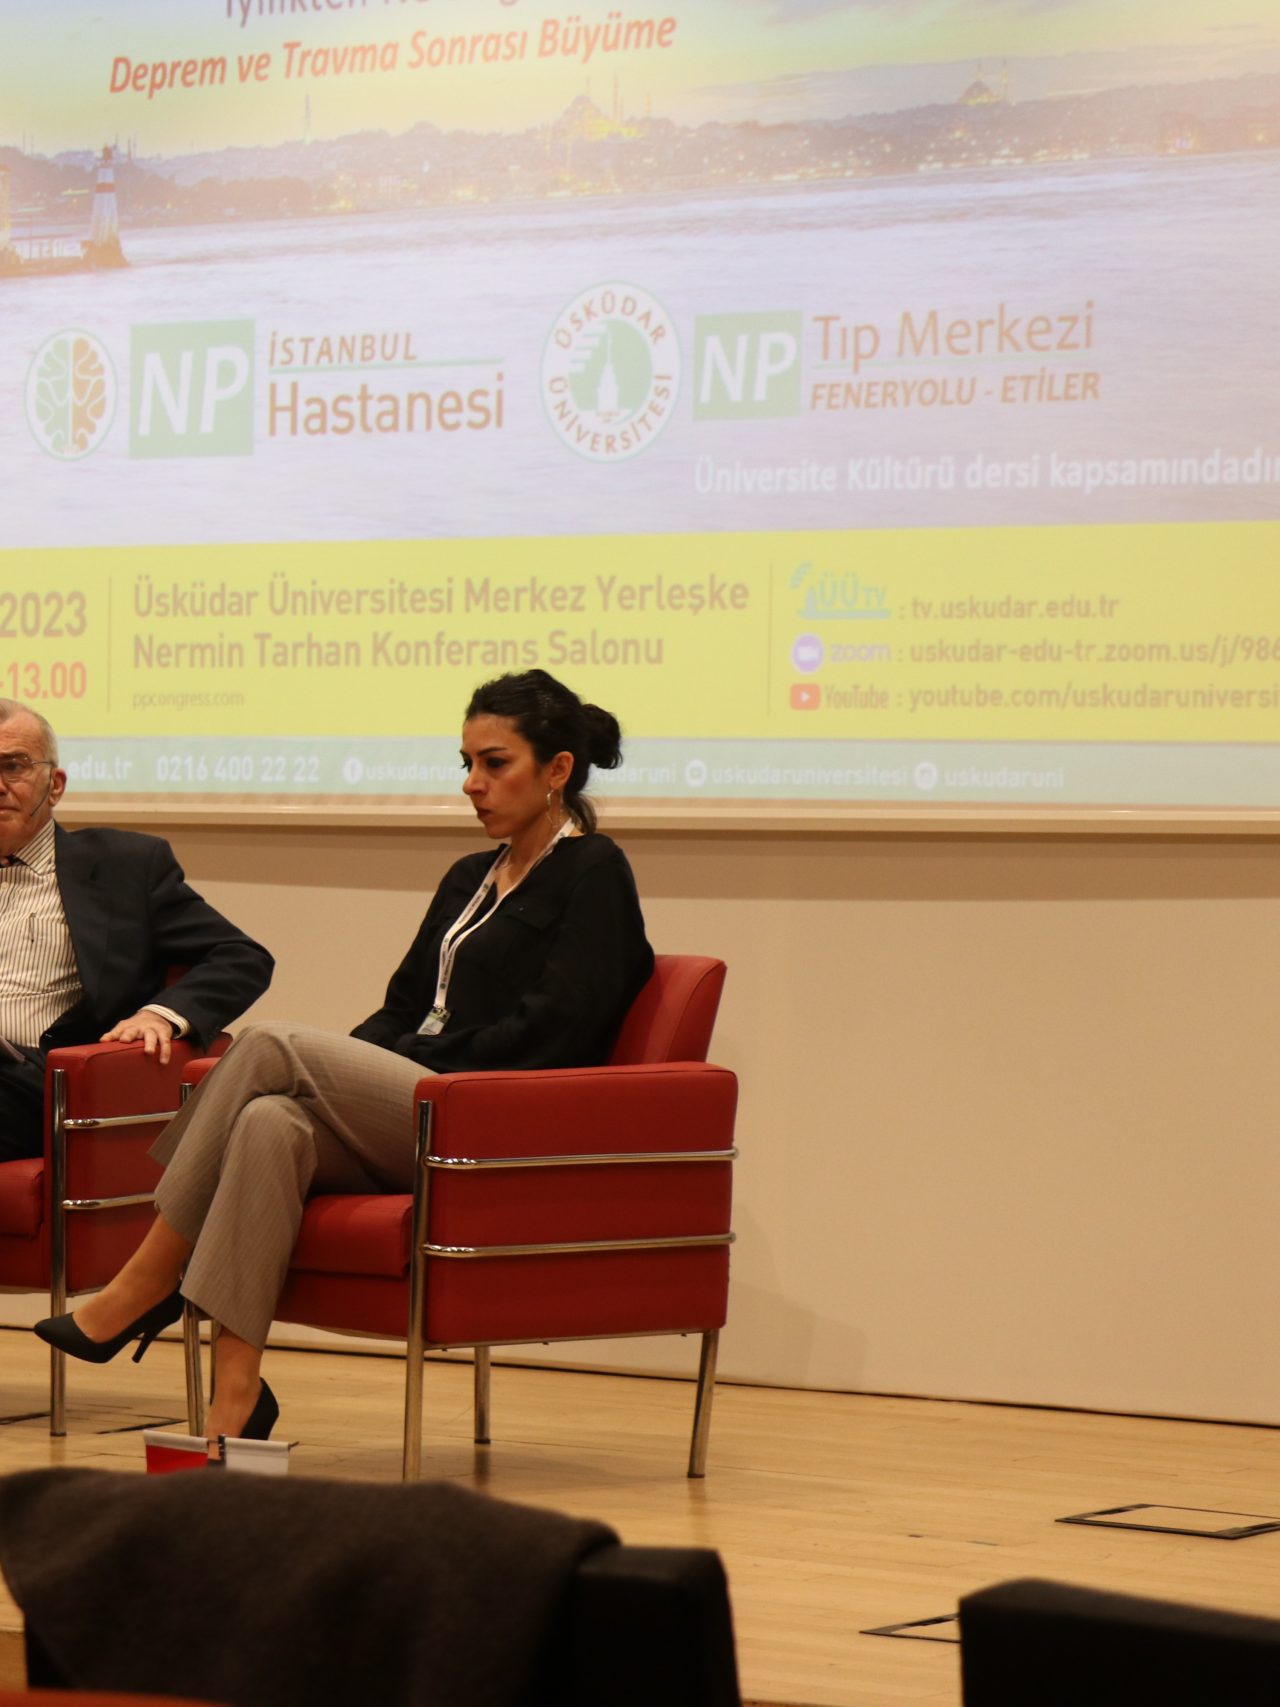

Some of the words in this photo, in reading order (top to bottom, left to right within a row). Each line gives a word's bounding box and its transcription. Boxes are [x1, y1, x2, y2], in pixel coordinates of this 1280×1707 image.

[109, 55, 228, 99] Deprem
[237, 51, 272, 82] ve
[282, 40, 400, 79] Travma
[407, 29, 529, 70] Sonrası
[537, 11, 678, 65] Büyüme
[268, 330, 418, 368] İSTANBUL
[812, 314, 882, 374] Tıp
[896, 299, 1096, 358] Merkezi
[699, 331, 798, 404] NP
[137, 345, 250, 437] NP
[268, 372, 505, 438] Hastanesi
[810, 376, 978, 412] FENERYOLU
[1000, 366, 1101, 405] ETİLER
[694, 454, 838, 495] Üniversite
[847, 455, 955, 491] Kültürü
[964, 453, 1041, 489] dersi
[134, 573, 260, 618] Üsküdar
[269, 570, 454, 617] Üniversitesi
[464, 576, 587, 614] Merkez
[595, 573, 750, 616] Yerleşke
[910, 593, 1121, 620] tv.uskudar.edu.tr
[133, 631, 245, 669] Nermin
[253, 631, 362, 668] Tarhan
[371, 629, 540, 667] Konferans
[547, 628, 664, 666] Salonu
[830, 643, 892, 663] zoom
[132, 689, 246, 711] ppcongress.com
[824, 683, 889, 710] YouTube
[156, 757, 208, 782] 0216
[213, 756, 253, 782] 400
[260, 757, 286, 783] 22
[293, 756, 320, 784] 22
[712, 764, 908, 787] uskudaruniversitesi
[944, 766, 1065, 789] uskudaruni
